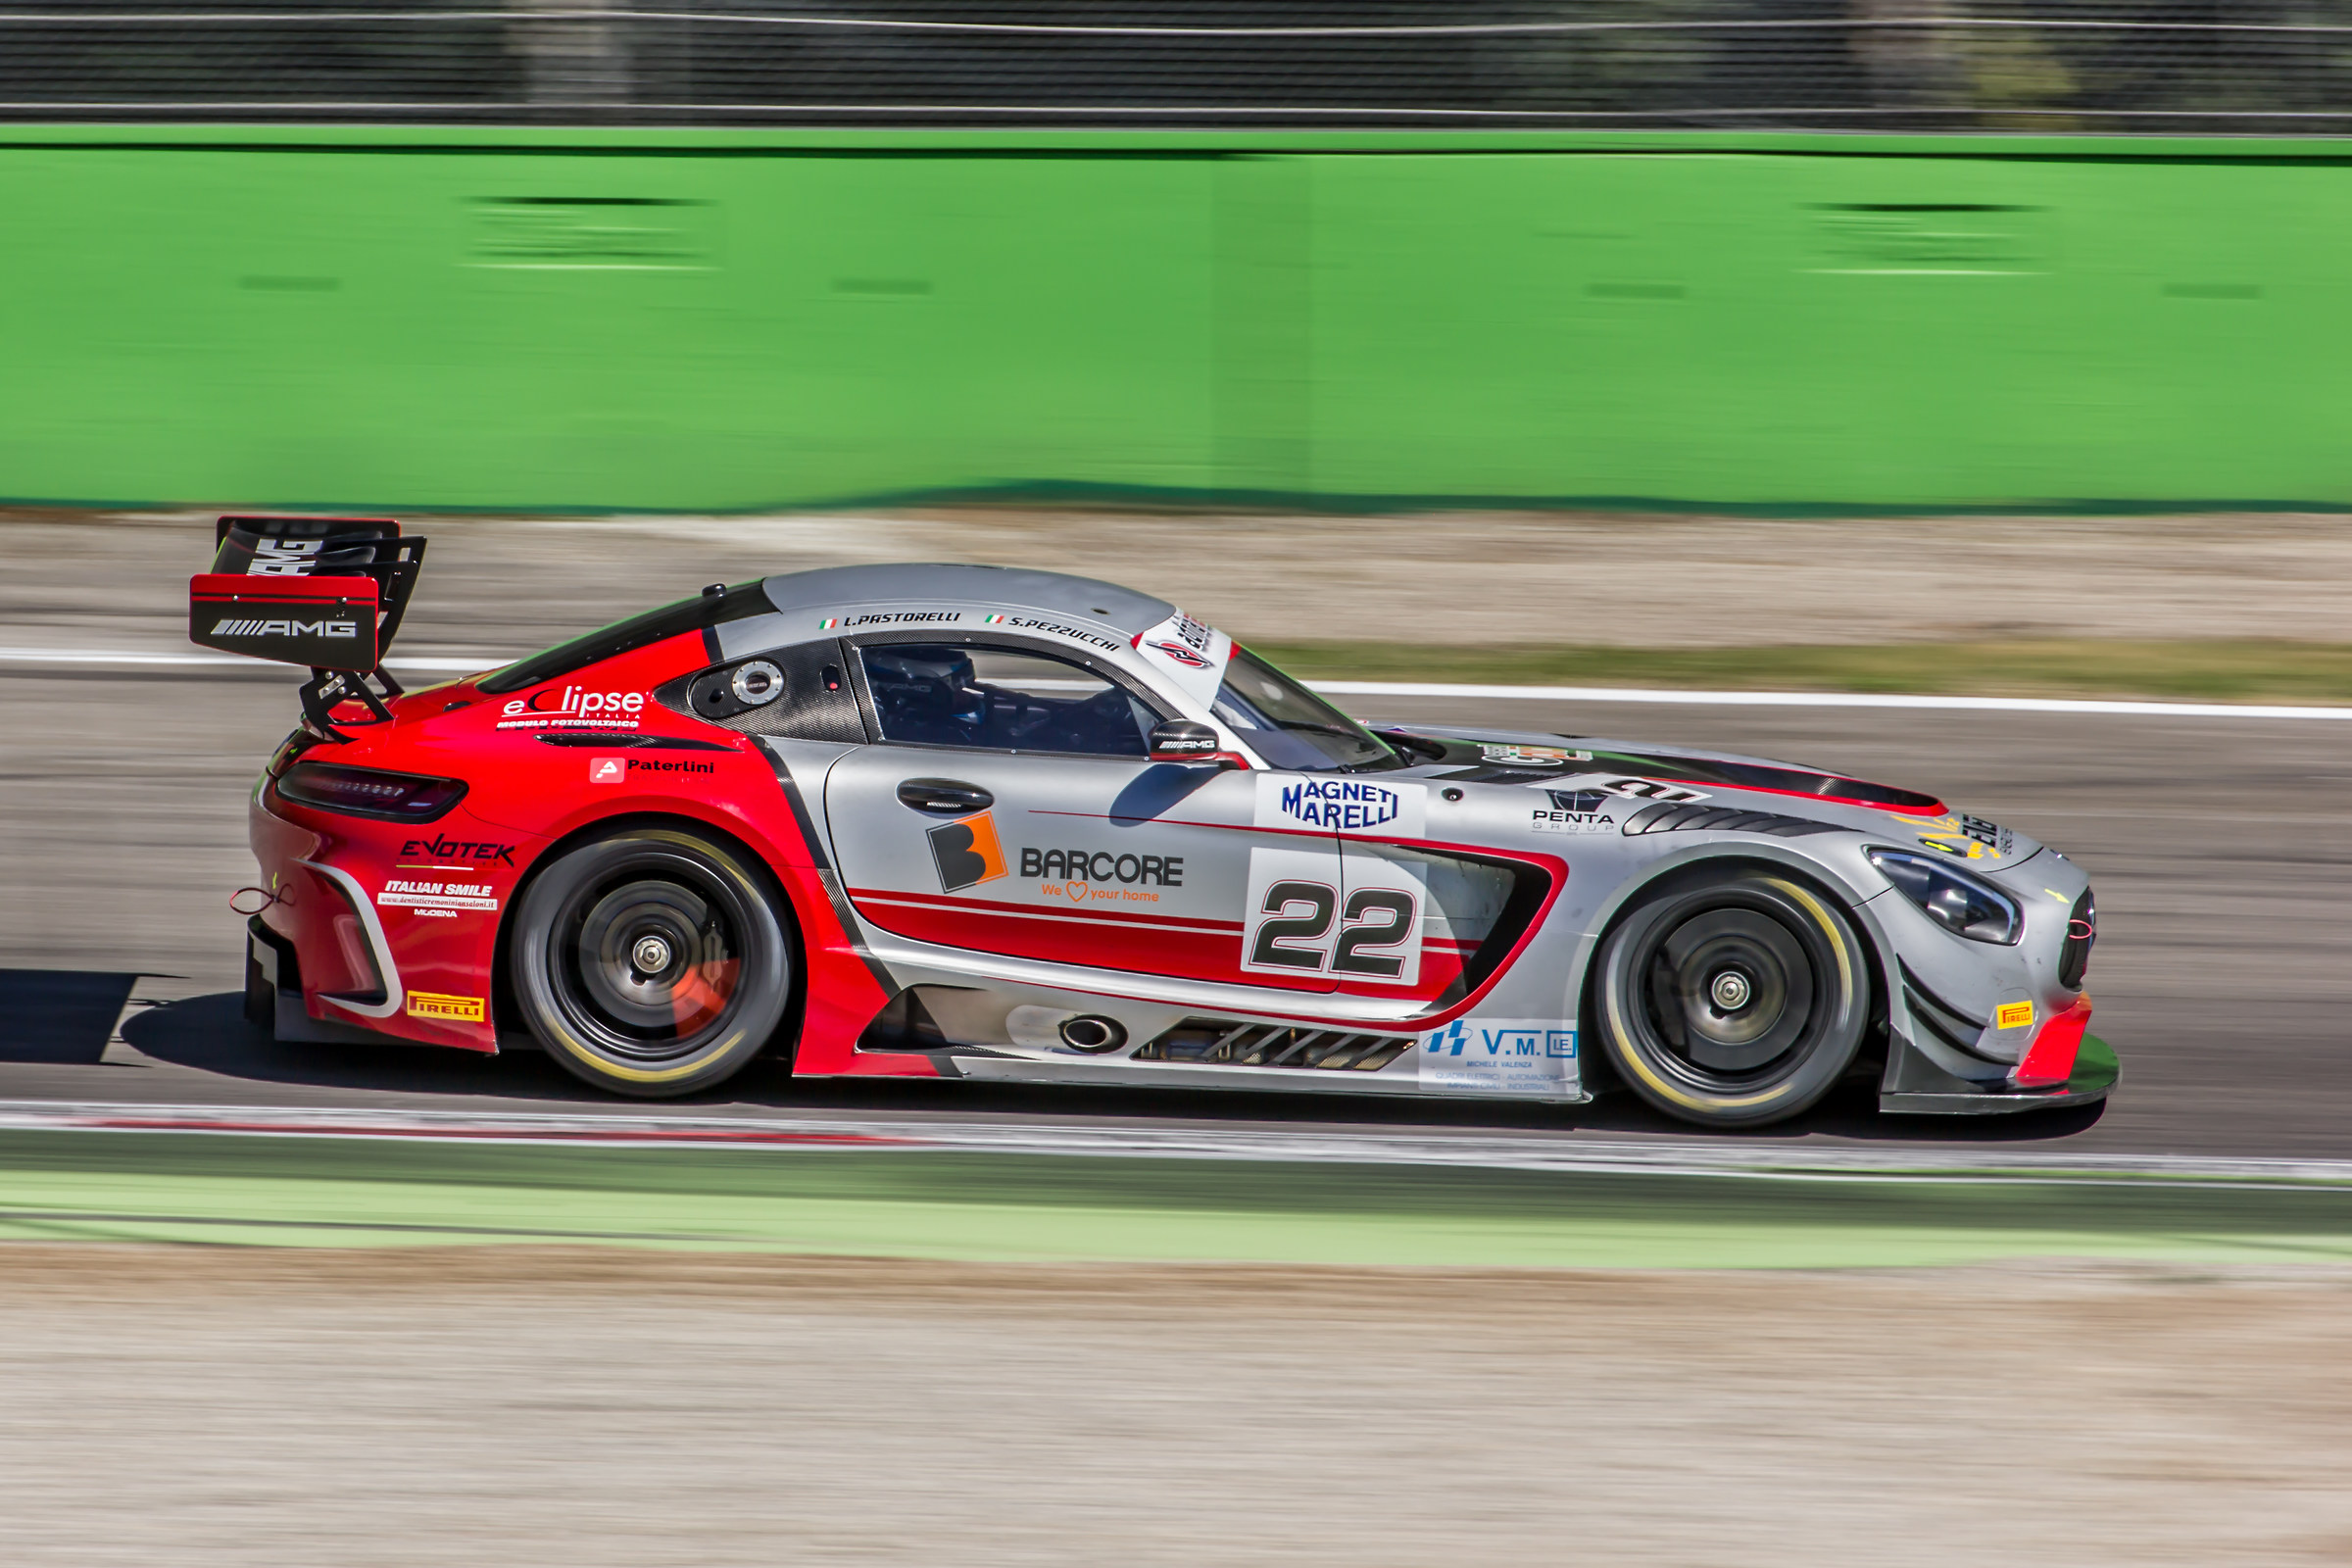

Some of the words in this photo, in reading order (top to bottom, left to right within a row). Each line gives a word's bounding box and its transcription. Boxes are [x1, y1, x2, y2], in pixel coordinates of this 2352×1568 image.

[844, 612, 961, 627] L.PASTORELLI
[257, 620, 356, 637] AMG
[628, 760, 714, 773] Paterlini
[1282, 781, 1398, 811] MAGNETI
[1282, 793, 1398, 828] MARELLI
[1533, 809, 1614, 824] PENTA
[1533, 822, 1614, 831] GROUP
[400, 833, 515, 867] EVOTEK
[1020, 847, 1184, 887] BARCORE
[385, 880, 443, 895] ITALIAN
[444, 883, 493, 897] SMILE
[1042, 884, 1062, 896] We
[1091, 889, 1120, 901] your
[1122, 888, 1160, 902] home
[1249, 879, 1417, 979] 22
[409, 995, 480, 1016] PIRELLI
[2002, 1006, 2031, 1023] PIRELLI
